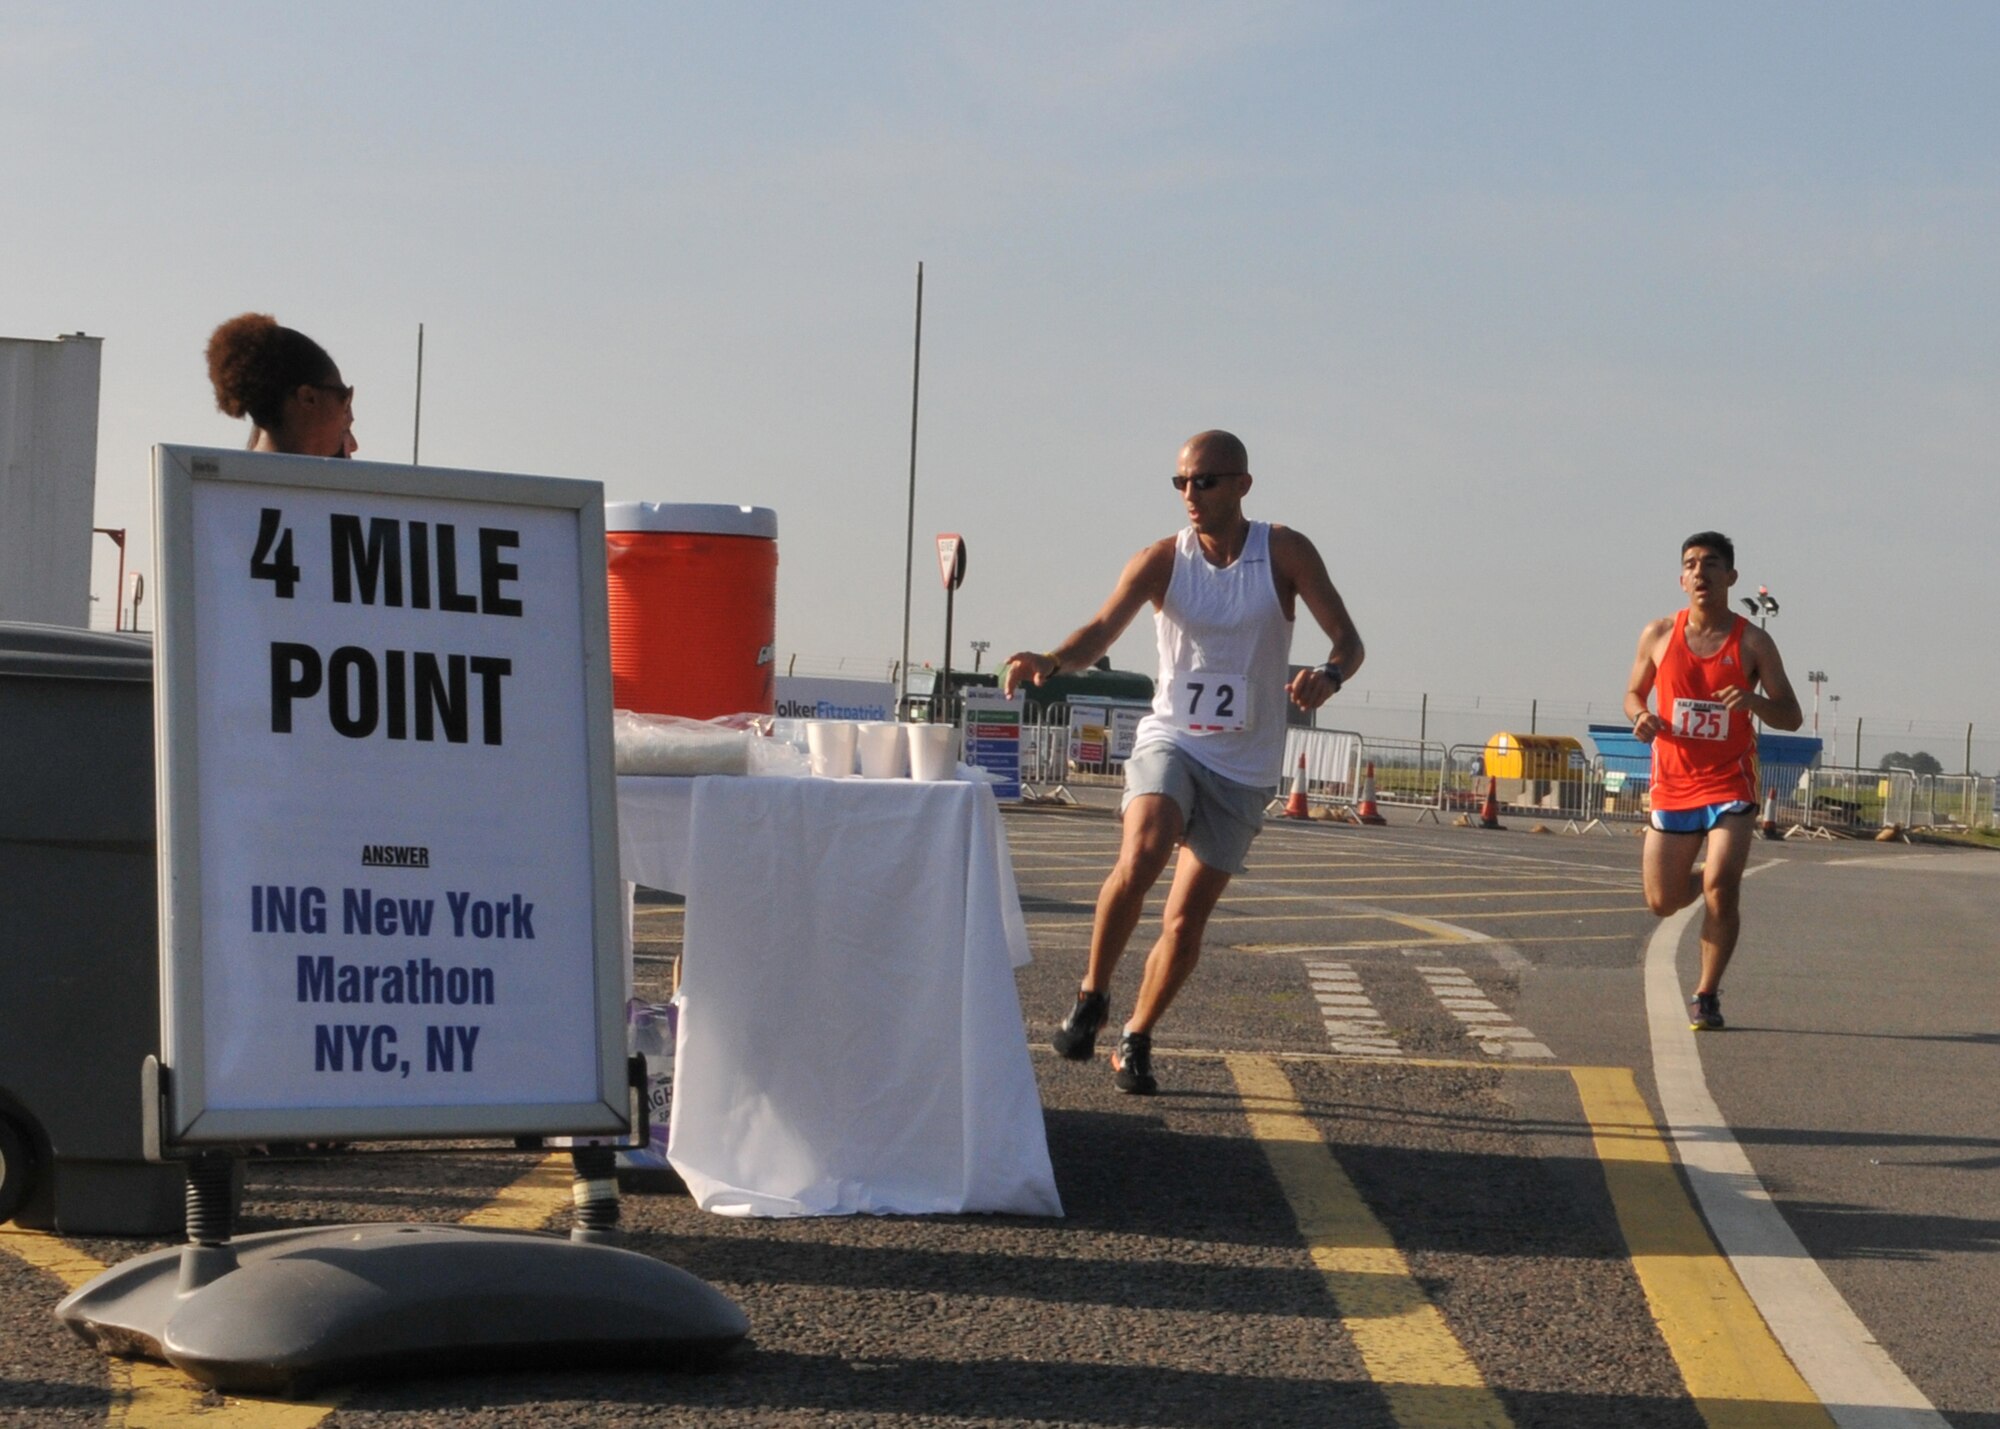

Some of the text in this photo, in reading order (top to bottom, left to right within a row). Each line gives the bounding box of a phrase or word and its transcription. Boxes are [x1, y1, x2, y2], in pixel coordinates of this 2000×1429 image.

[251, 508, 523, 618] 4 MILE
[271, 642, 512, 746] POINT
[775, 699, 887, 720] olkerFitzpatrick
[1680, 711, 1722, 738] 125
[362, 845, 430, 868] ANSWER
[252, 886, 536, 940] ING New York
[298, 956, 495, 1006] Marathon
[316, 1025, 481, 1079] NYC, NY
